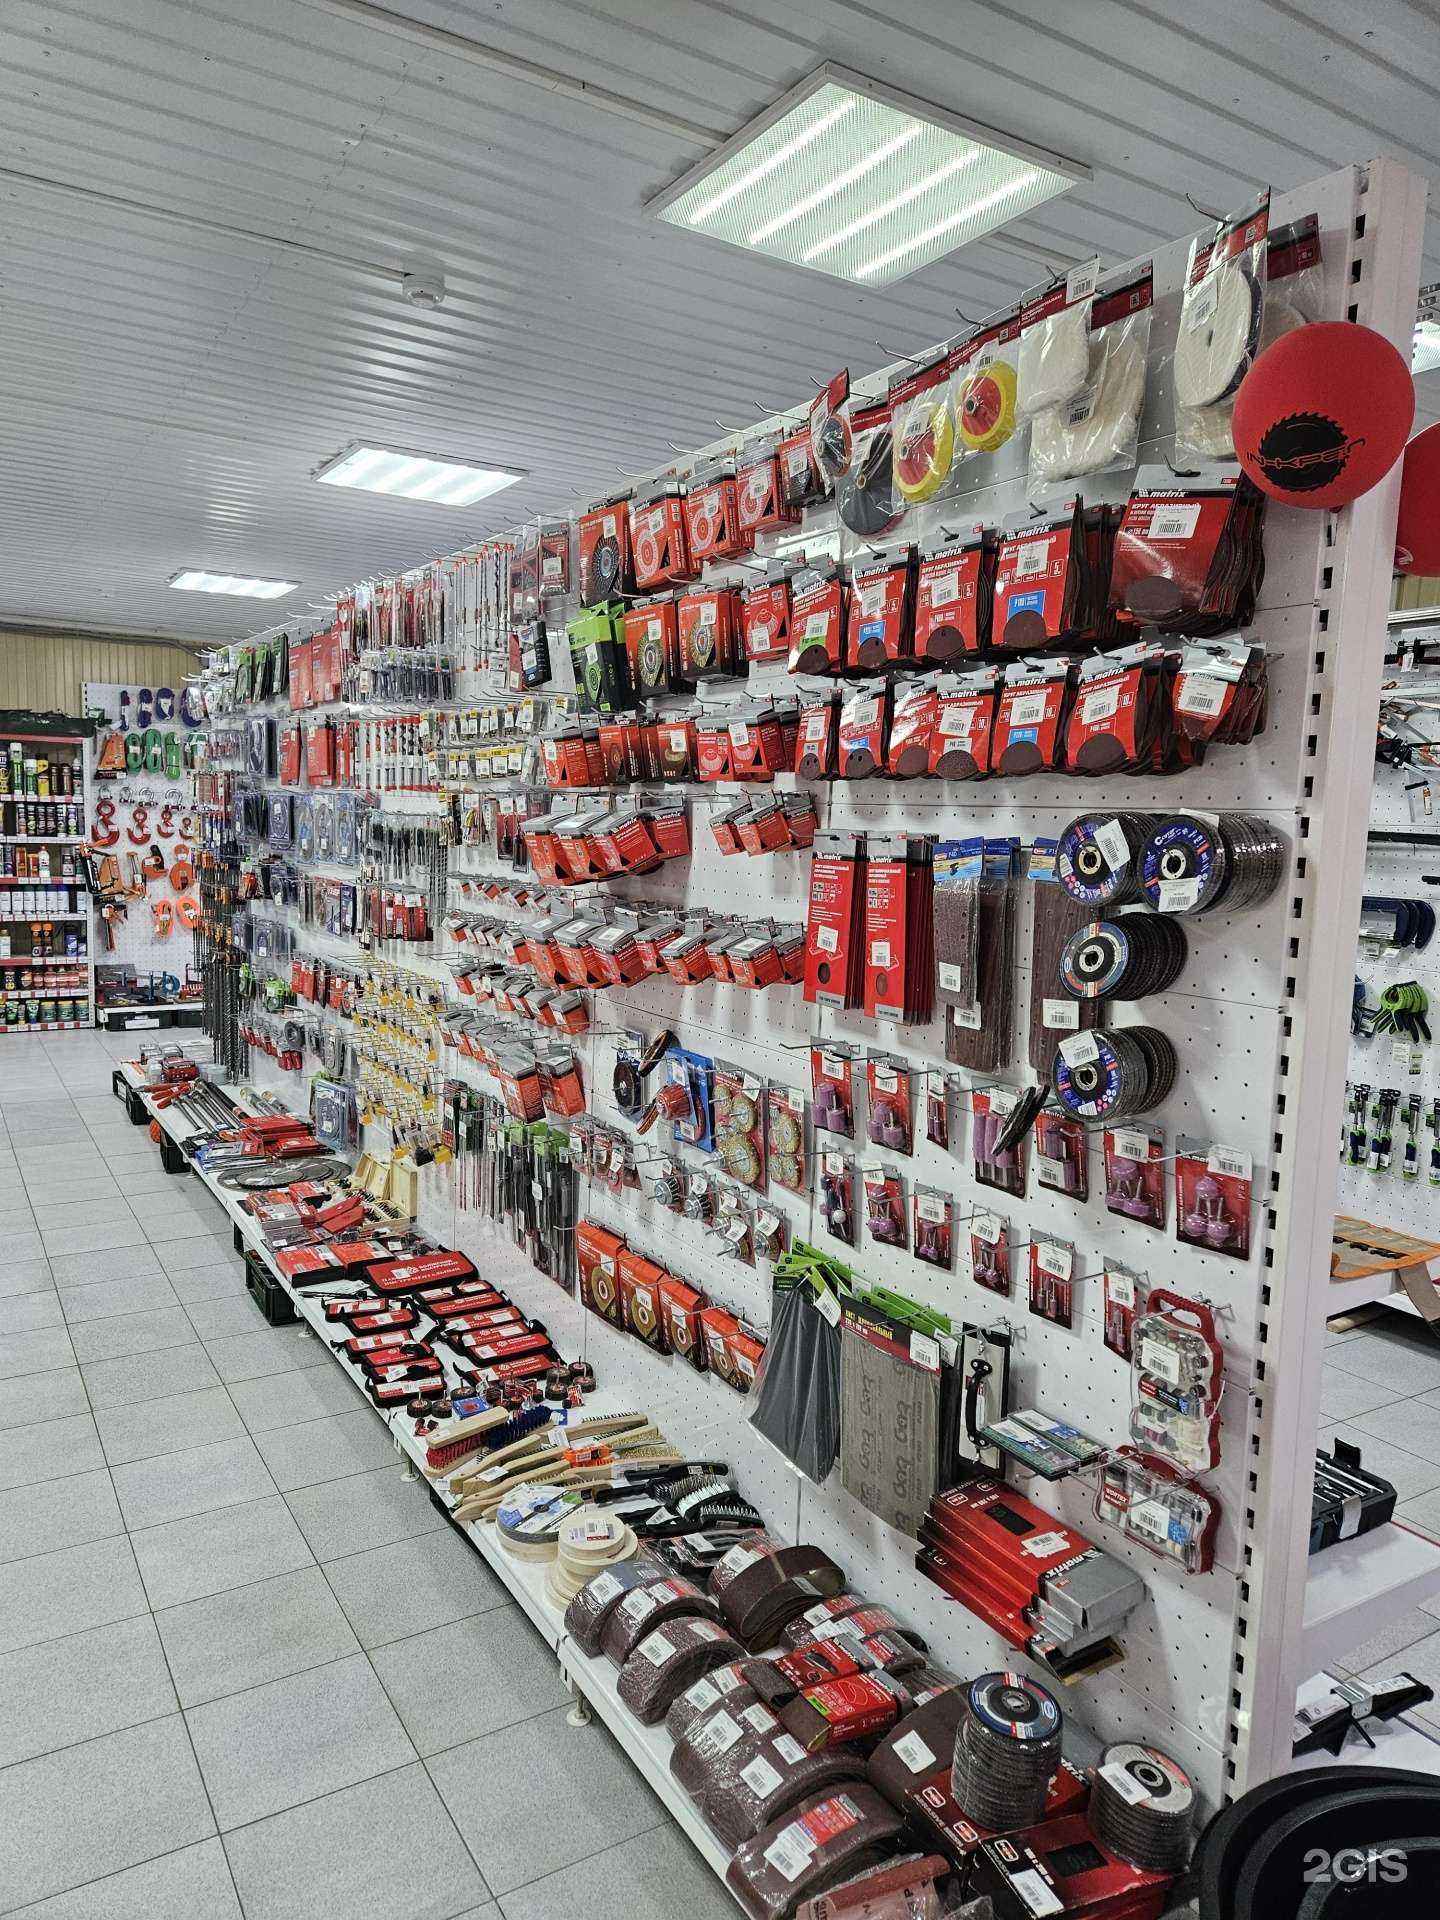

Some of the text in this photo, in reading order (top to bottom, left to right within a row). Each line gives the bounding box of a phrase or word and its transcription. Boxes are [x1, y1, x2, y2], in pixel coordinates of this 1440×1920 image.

[1149, 488, 1187, 498] matrix
[1017, 523, 1051, 539] matrix
[935, 547, 963, 560] matrix
[864, 563, 890, 576] matrix
[1094, 666, 1126, 680] matrix
[1017, 676, 1048, 688] matrix
[949, 688, 978, 697] matrix
[1048, 1554, 1085, 1578] matrix
